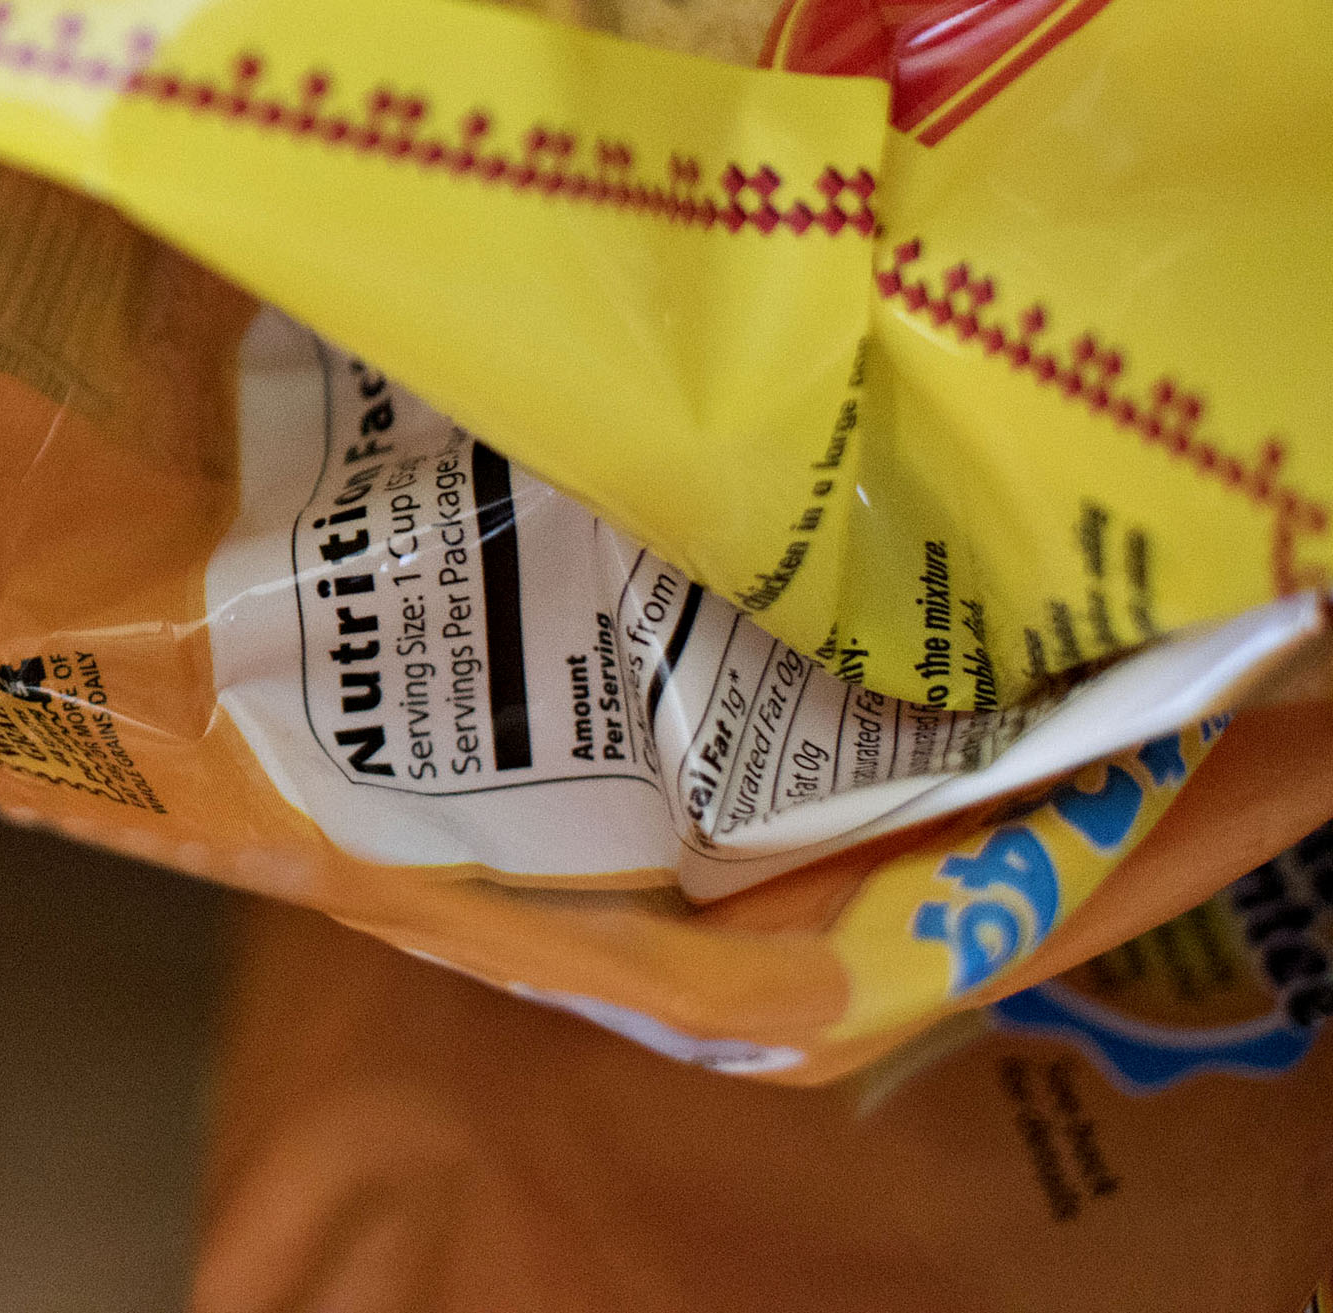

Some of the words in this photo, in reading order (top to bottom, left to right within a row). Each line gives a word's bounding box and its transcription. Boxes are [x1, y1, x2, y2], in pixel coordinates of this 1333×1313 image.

[387, 491, 422, 560] Cup
[392, 573, 422, 587] 1
[916, 540, 951, 632] mixture.
[312, 464, 401, 776] Nutrition
[396, 595, 428, 657] Size:
[441, 594, 473, 640] Per
[50, 652, 76, 680] OF
[74, 650, 108, 708] DAILY
[594, 612, 621, 712] Serving
[914, 636, 952, 680] the
[61, 695, 92, 745] MORE
[401, 661, 438, 780] Serving
[446, 644, 484, 775] Servings
[567, 655, 594, 761] Amount
[89, 709, 134, 769] GRAINS
[602, 717, 626, 761] Per
[704, 714, 736, 774] Fat
[721, 734, 774, 835] turated
[759, 686, 792, 733] Fat
[776, 648, 807, 689] 0g
[792, 739, 831, 772] 0g
